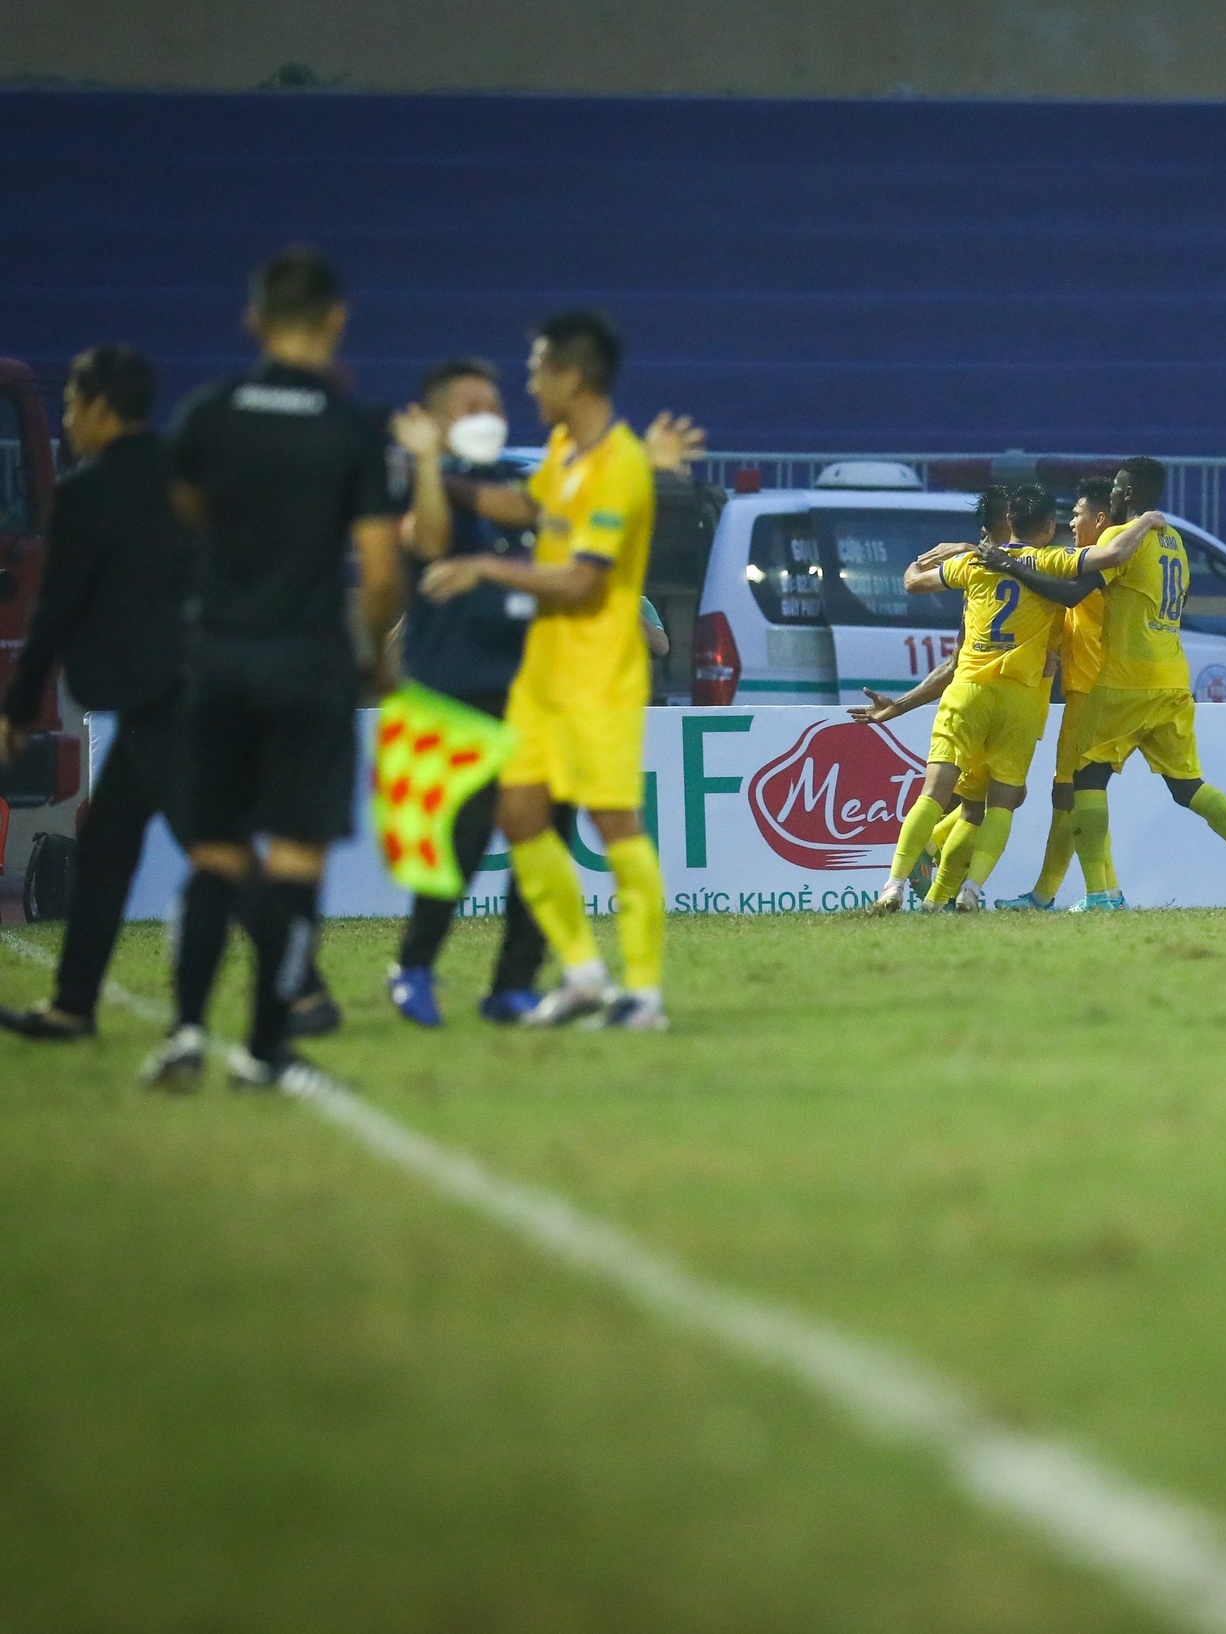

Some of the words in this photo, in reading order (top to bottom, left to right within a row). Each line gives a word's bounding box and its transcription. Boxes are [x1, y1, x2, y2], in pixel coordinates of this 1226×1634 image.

[990, 580, 1020, 642] 2
[1159, 555, 1182, 621] 10
[777, 757, 927, 840] Meat
[674, 887, 731, 913] SỨC
[739, 884, 814, 913] KHOẺ
[821, 885, 883, 912] CÔN
